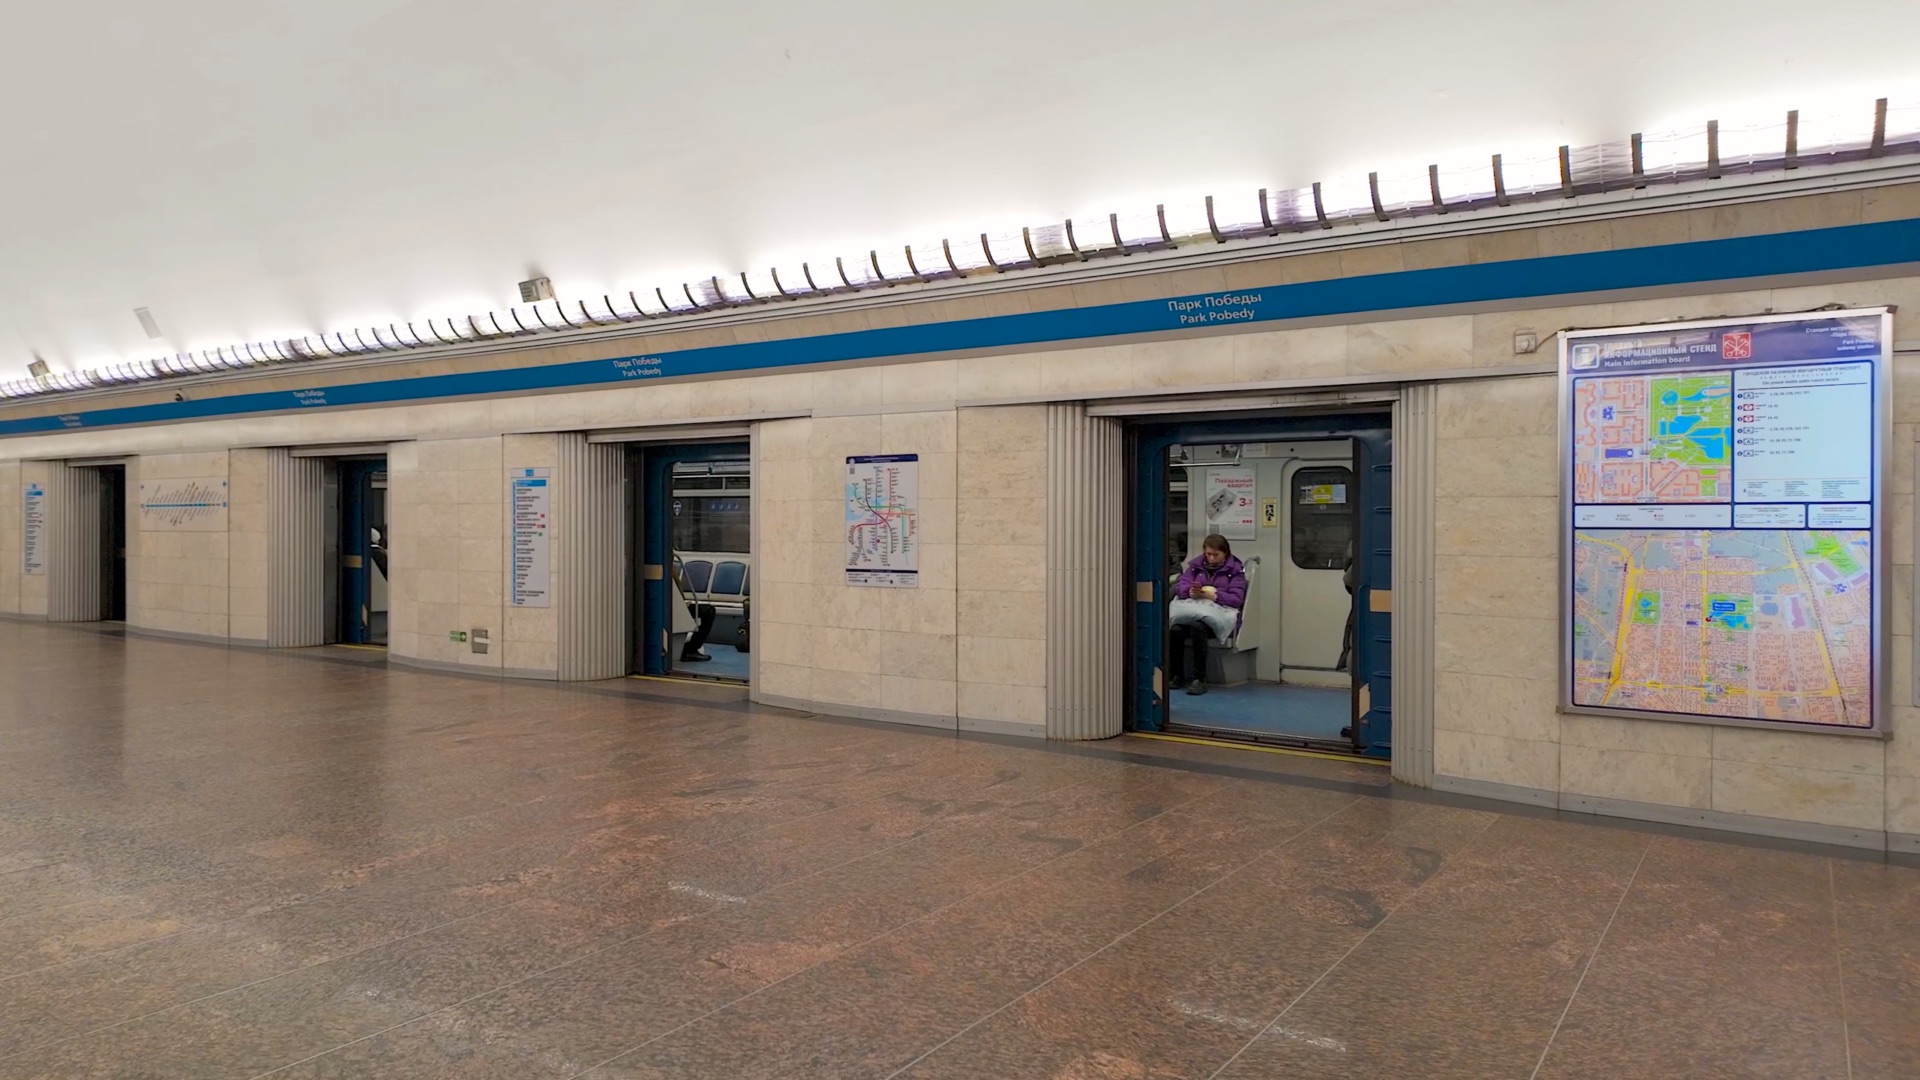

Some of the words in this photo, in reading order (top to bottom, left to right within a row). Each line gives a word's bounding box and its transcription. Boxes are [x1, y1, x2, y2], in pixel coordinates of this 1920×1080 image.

[1168, 299, 1202, 312] Парк
[1204, 294, 1262, 307] Победы
[1180, 311, 1207, 324] Park
[1208, 308, 1255, 322] Pobedy
[1604, 346, 1687, 358] ИНФОРМАЦИОННЫЙ
[1690, 343, 1717, 353] СТЕНД
[613, 360, 632, 368] Парк
[632, 357, 662, 366] Победы
[1604, 359, 1622, 368] Main
[1623, 357, 1668, 366] information
[1668, 355, 1691, 363] board
[638, 368, 661, 376] Pobedy
